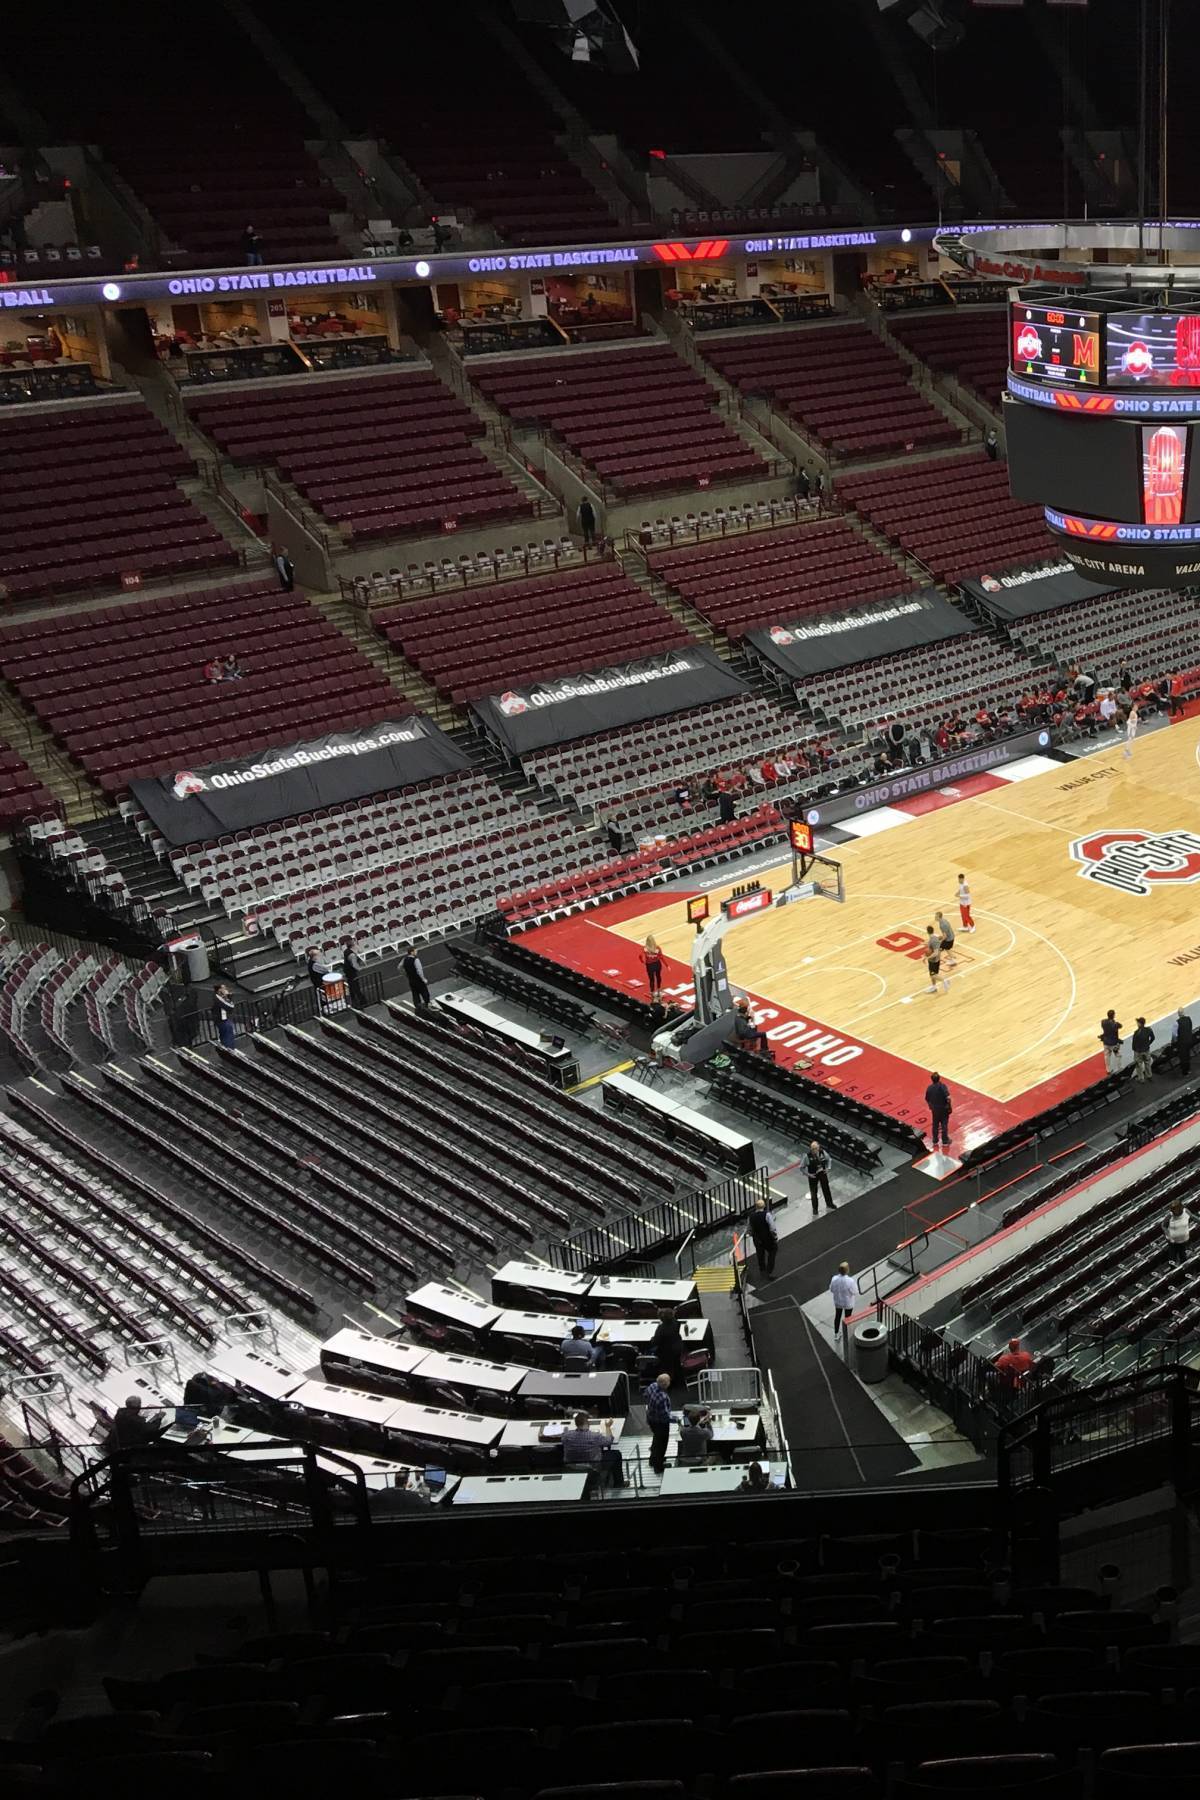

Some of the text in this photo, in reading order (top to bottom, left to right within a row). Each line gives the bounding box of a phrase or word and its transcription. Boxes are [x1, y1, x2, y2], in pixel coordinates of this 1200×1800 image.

[811, 232, 877, 248] BASKETBALL
[469, 248, 639, 272] OHIO STATE BASKETBALL
[168, 266, 377, 295] OHIO STATE BASKETBALL
[1073, 334, 1095, 367] M
[1114, 399, 1150, 412] OHIO
[1153, 400, 1193, 412] STATE
[444, 520, 457, 530] 105
[1116, 527, 1151, 540] OHIO
[1153, 529, 1192, 540] STATE
[124, 575, 140, 585] 104
[1001, 562, 1076, 588] OhioStateBucke
[1084, 558, 1106, 571] CITY
[1109, 563, 1145, 576] ARENA
[794, 601, 923, 641] OhioStateBuckeyes.com
[530, 658, 691, 707] OhioStateBuckeyes.com
[210, 728, 415, 790] OhioStateBuckeyes.com
[854, 747, 1010, 809] OHIO STATE BASKETBALL
[1055, 766, 1120, 792] VALUE CITY
[765, 1020, 864, 1067] OHIO
